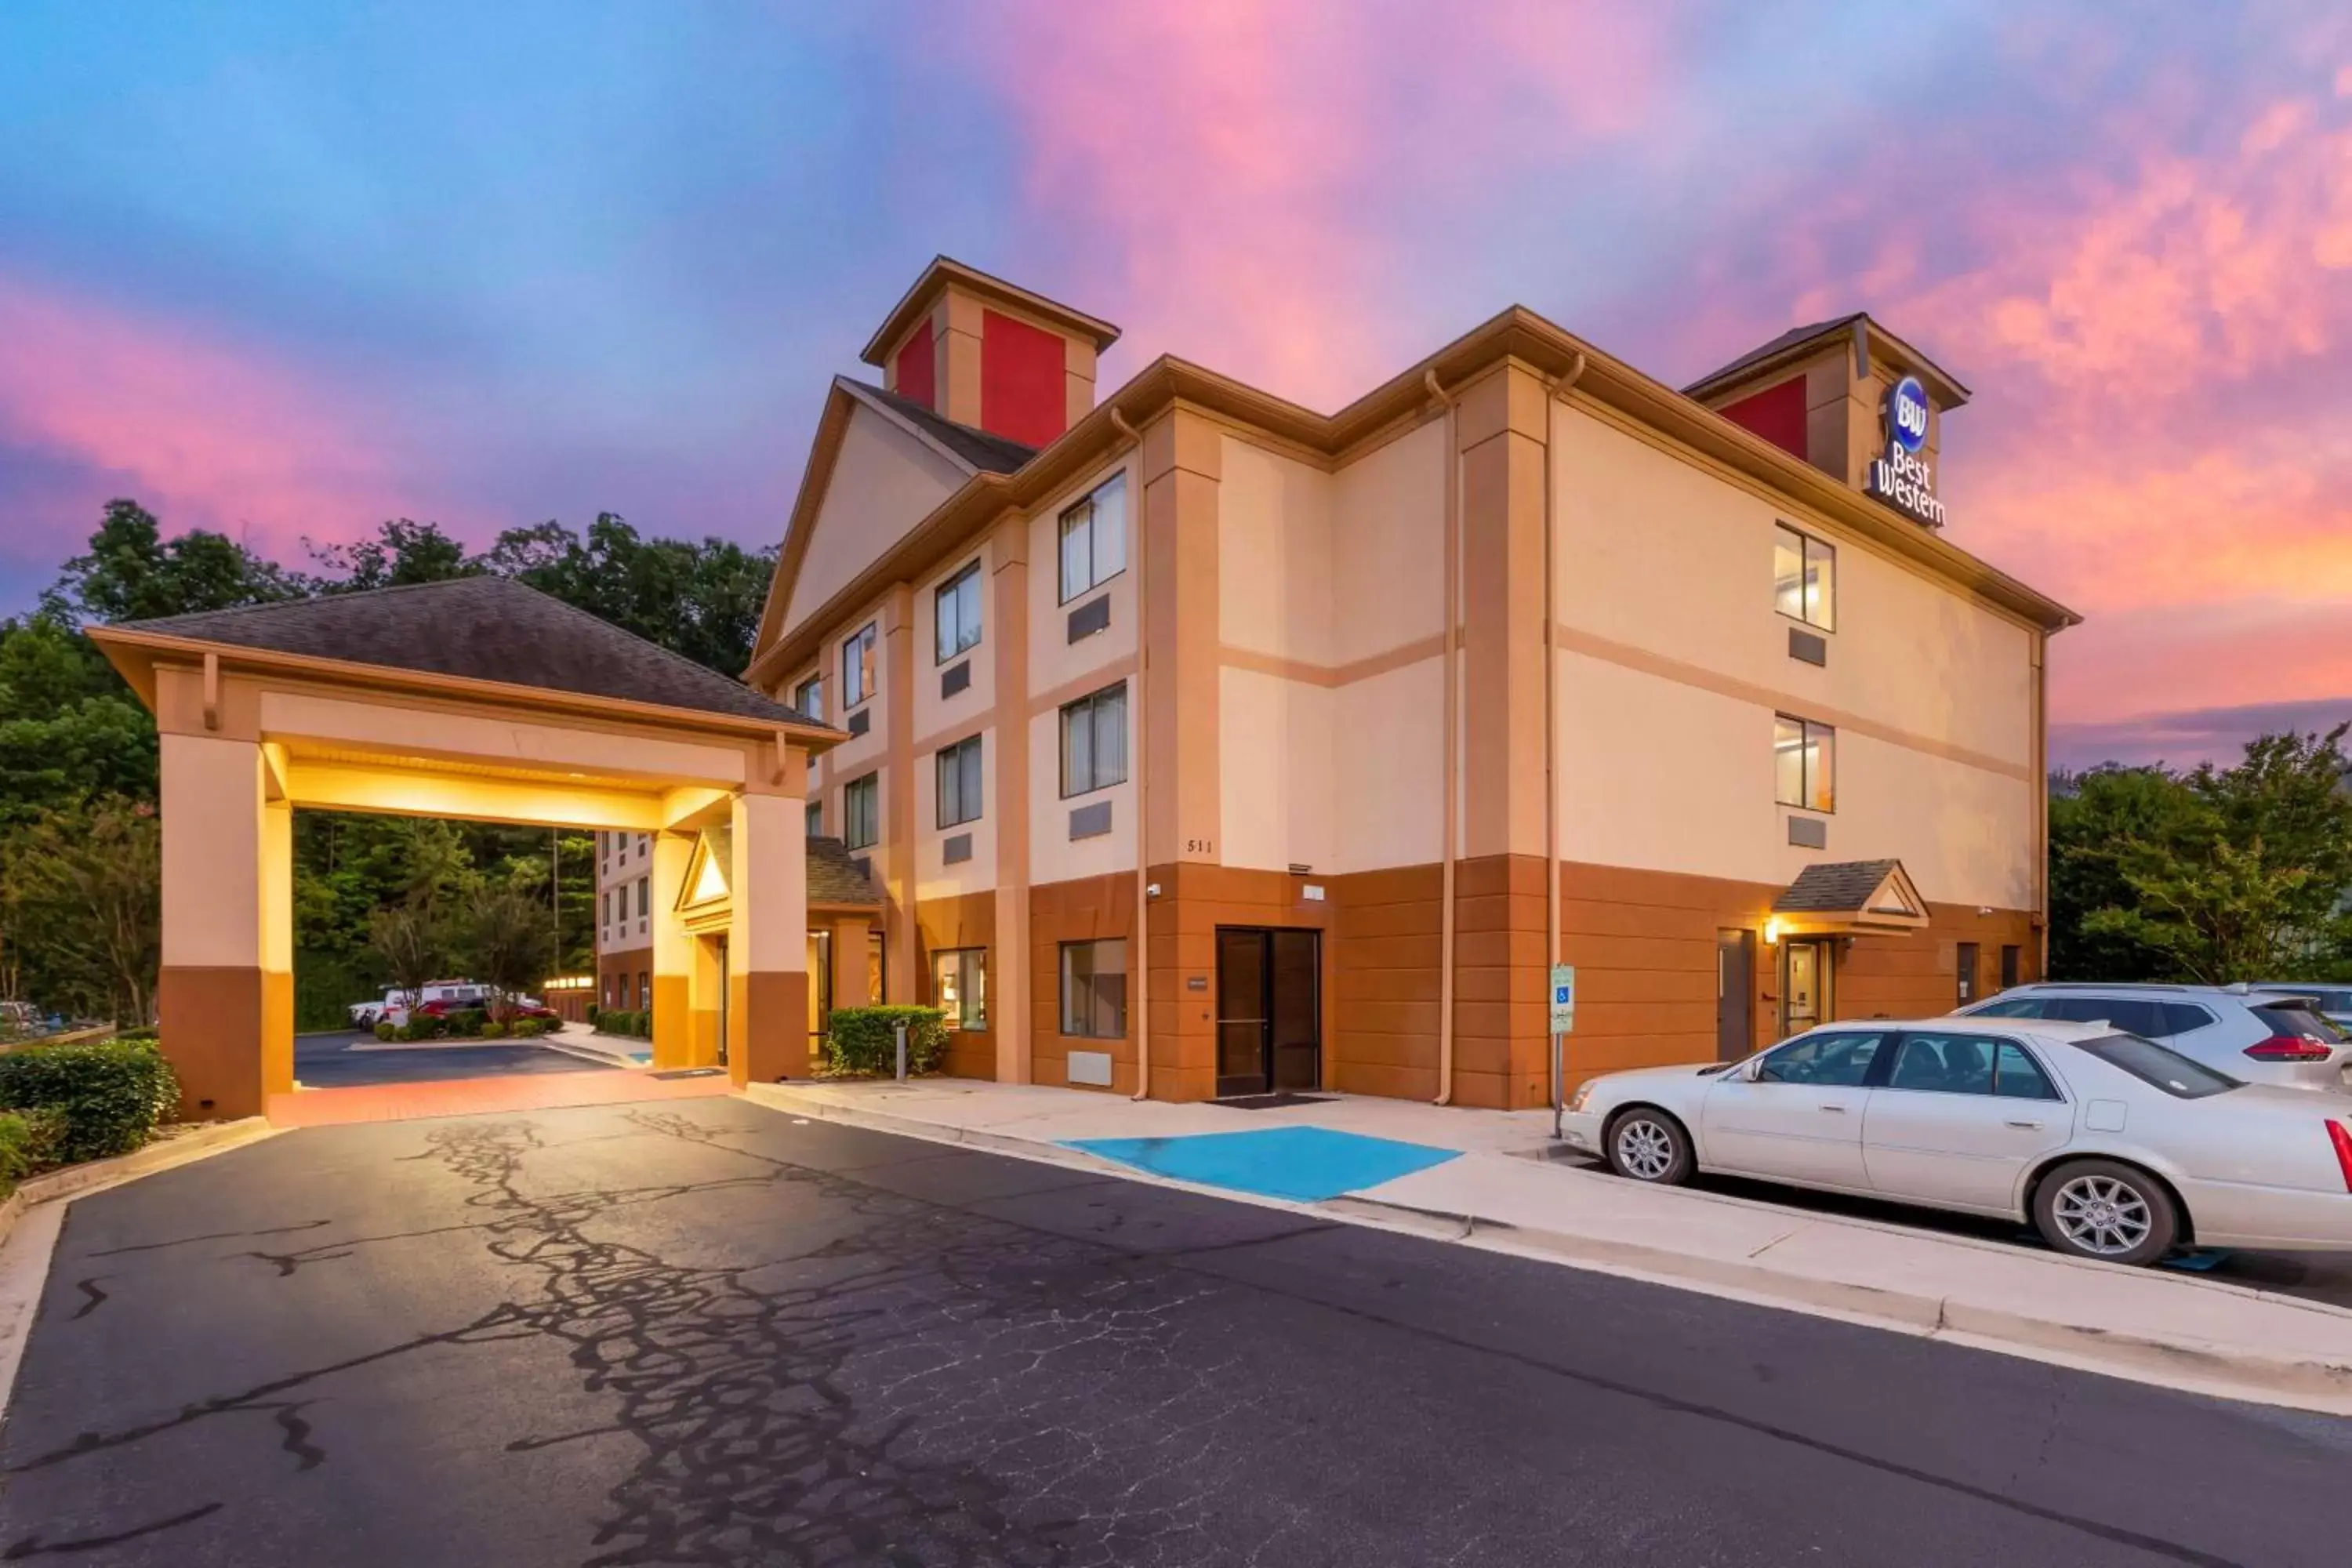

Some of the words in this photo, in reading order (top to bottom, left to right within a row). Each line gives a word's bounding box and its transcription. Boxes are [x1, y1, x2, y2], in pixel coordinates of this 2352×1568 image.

[1898, 394, 1926, 437] BW
[1893, 441, 1930, 490] Best
[1878, 459, 1947, 525] Western
[1188, 840, 1211, 853] 511
